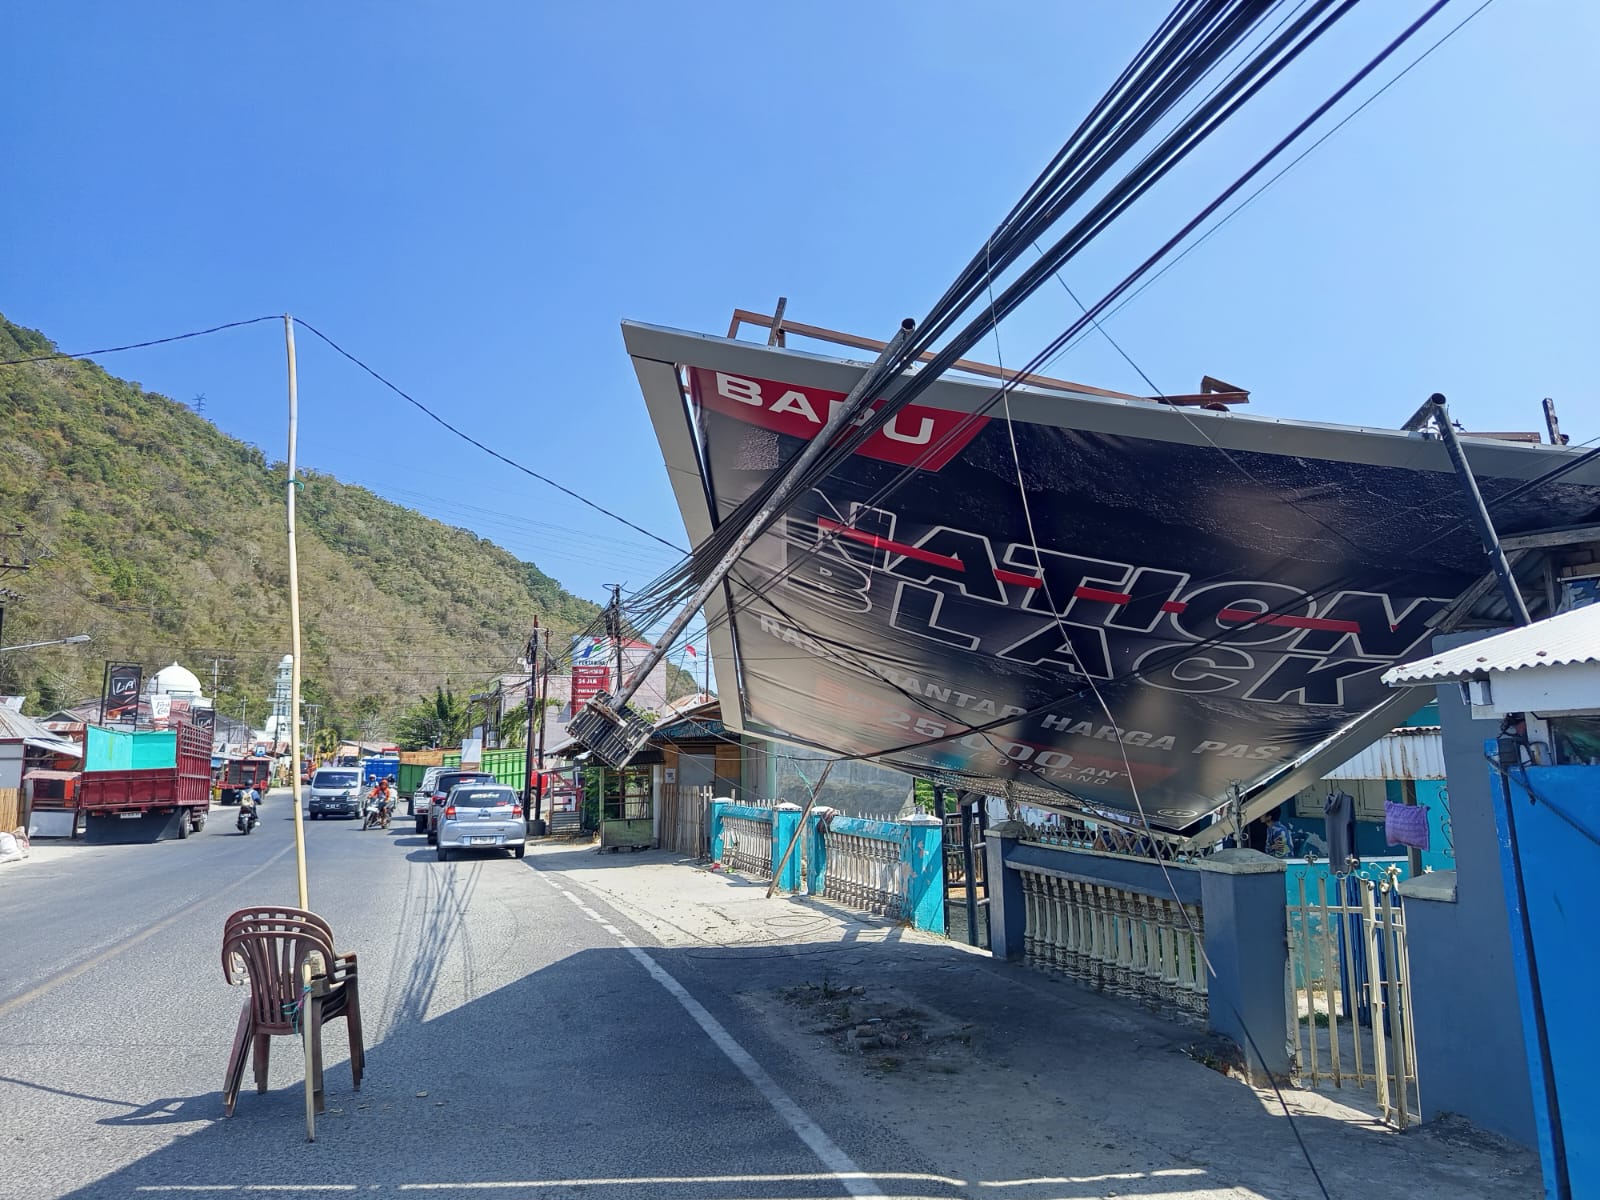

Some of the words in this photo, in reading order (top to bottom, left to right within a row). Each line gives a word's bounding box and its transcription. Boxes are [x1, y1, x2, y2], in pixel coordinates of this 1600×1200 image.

[784, 487, 1456, 659] NATION
[784, 534, 1395, 707] BLACK
[1041, 714, 1176, 750] HARGA
[1191, 740, 1281, 760] PAS
